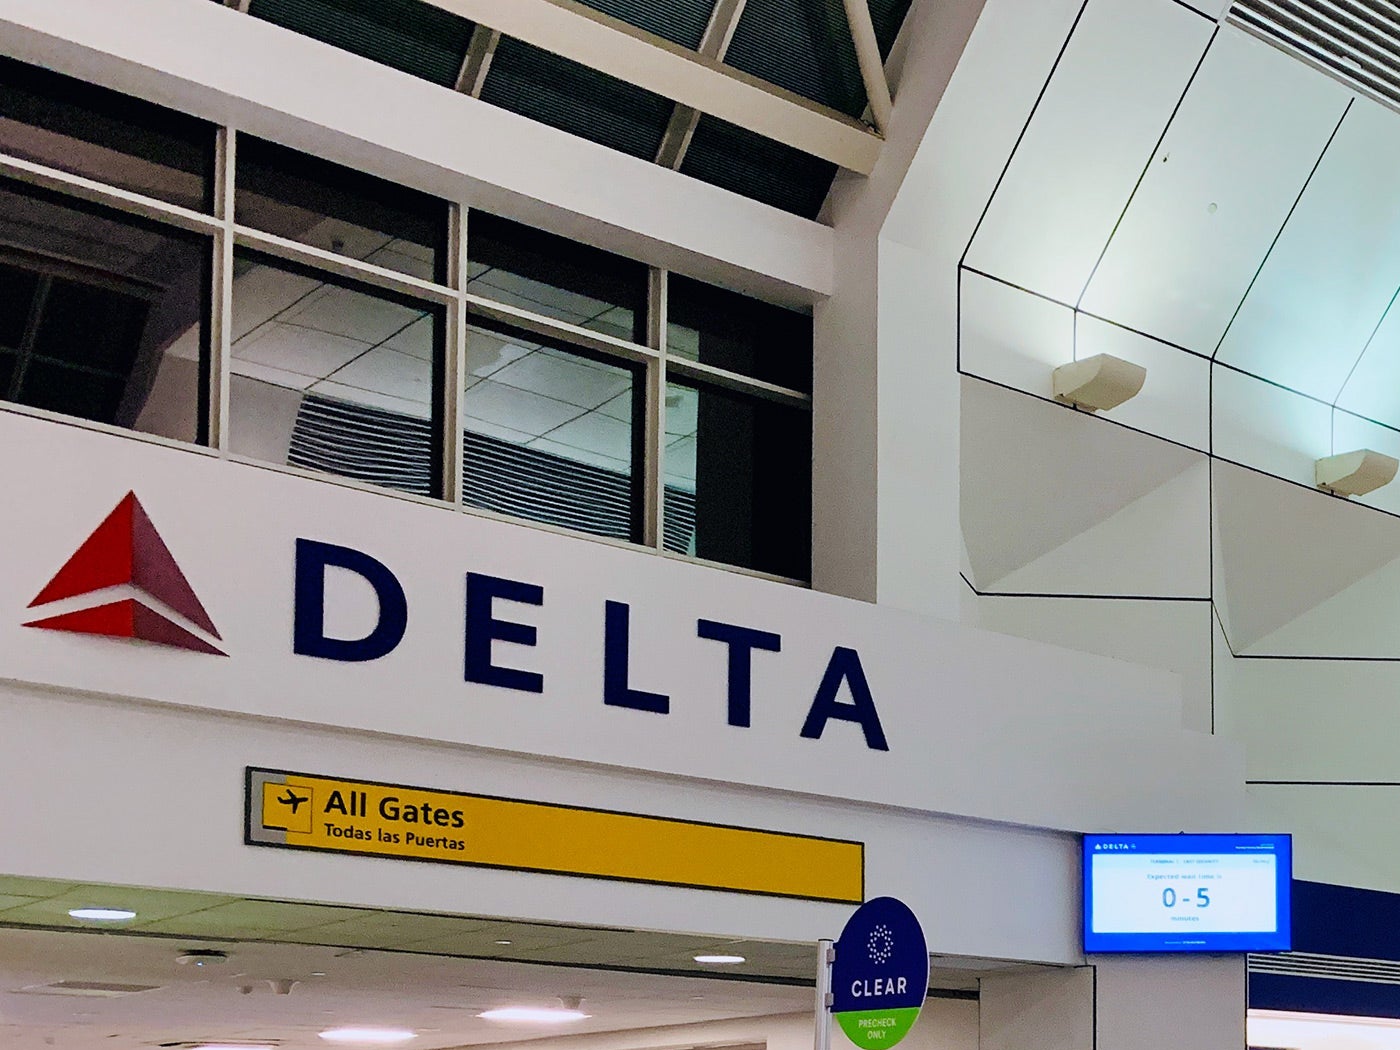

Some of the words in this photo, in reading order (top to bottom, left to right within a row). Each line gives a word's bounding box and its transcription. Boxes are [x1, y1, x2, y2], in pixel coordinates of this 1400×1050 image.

[293, 537, 890, 752] DELTA
[323, 790, 367, 818] All
[378, 796, 465, 829] Gates
[323, 822, 373, 841] Todas
[377, 827, 401, 844] las
[405, 831, 466, 851] Puertas
[1162, 887, 1177, 908] 0
[1196, 887, 1211, 908] 5
[851, 976, 907, 998] CLEAR
[858, 1017, 897, 1029] PRECHECK
[867, 1030, 887, 1040] ONLY
